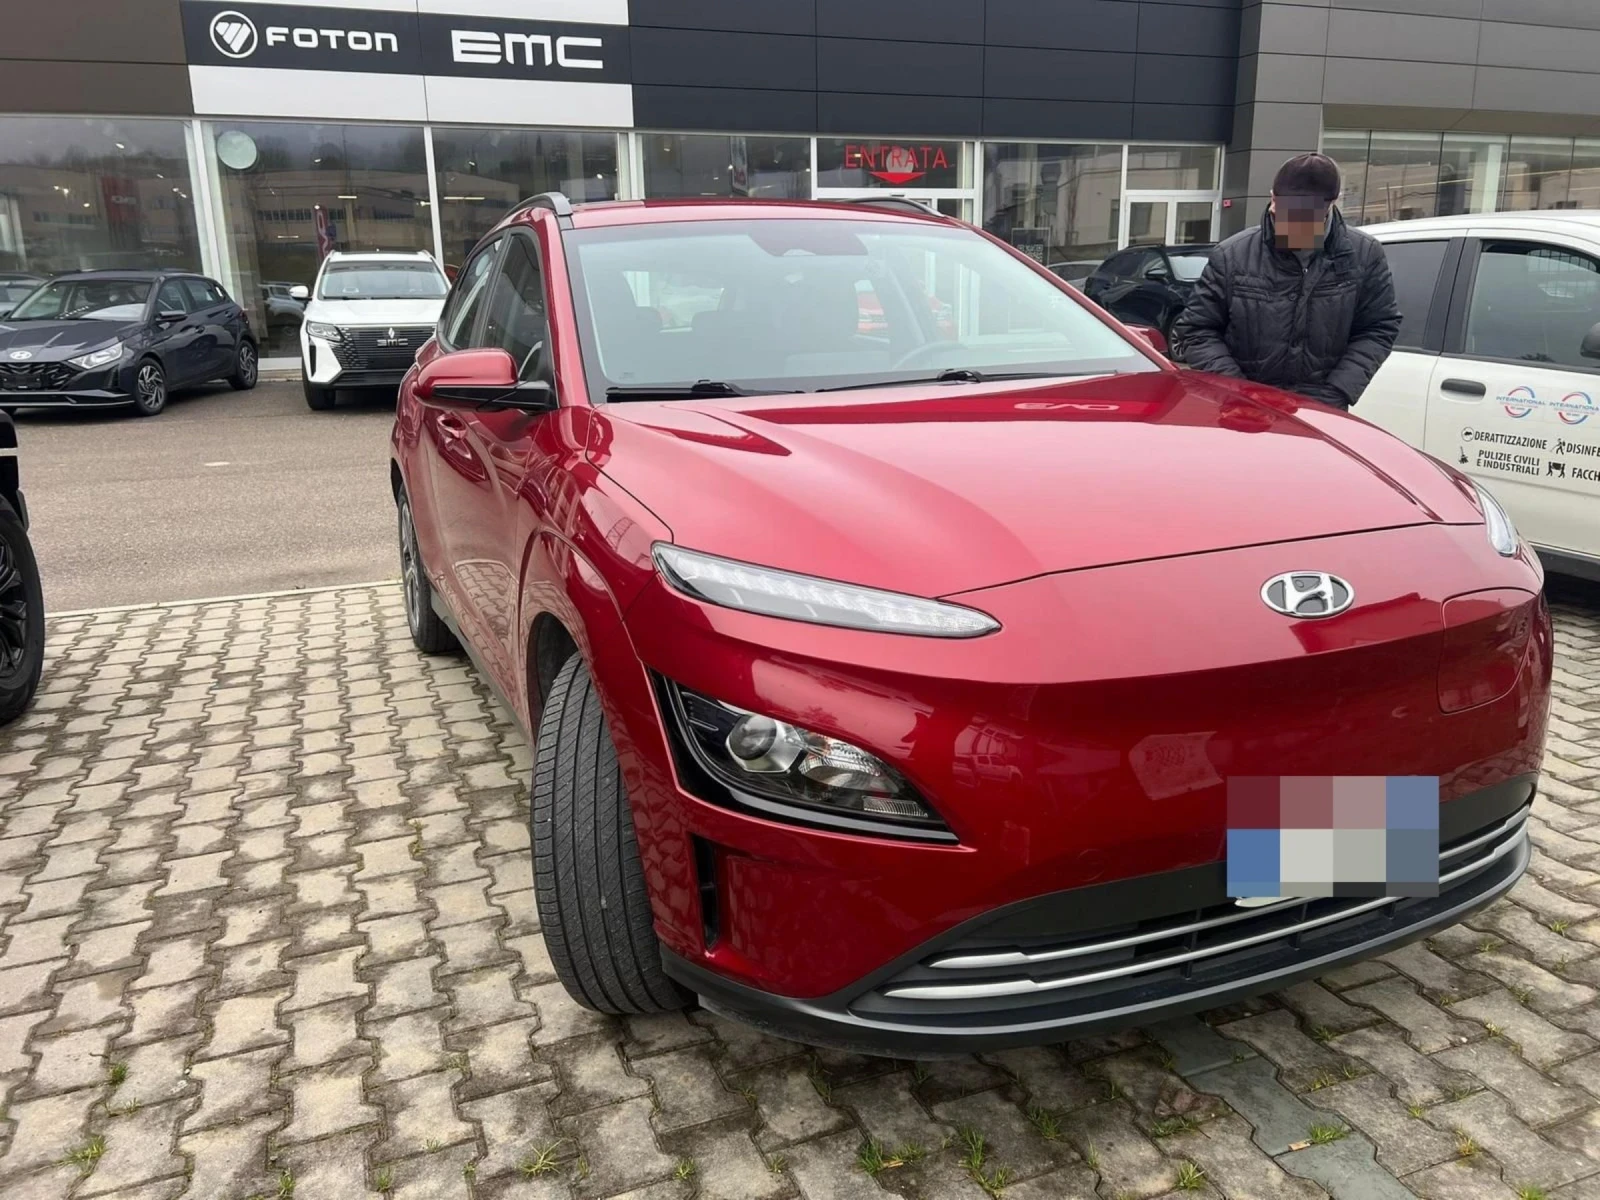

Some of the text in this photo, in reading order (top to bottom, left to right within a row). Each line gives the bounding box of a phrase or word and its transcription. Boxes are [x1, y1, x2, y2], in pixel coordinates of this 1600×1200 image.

[266, 27, 399, 53] FOTON
[451, 29, 603, 69] EMC
[845, 145, 947, 169] ENTRATA
[1496, 396, 1546, 405] INTERNATIONAL
[1474, 431, 1548, 450] DERATTIZZAZIONE
[1476, 458, 1540, 476] E INDUSTRIALI
[1479, 449, 1540, 466] PULIZIE CIVILI
